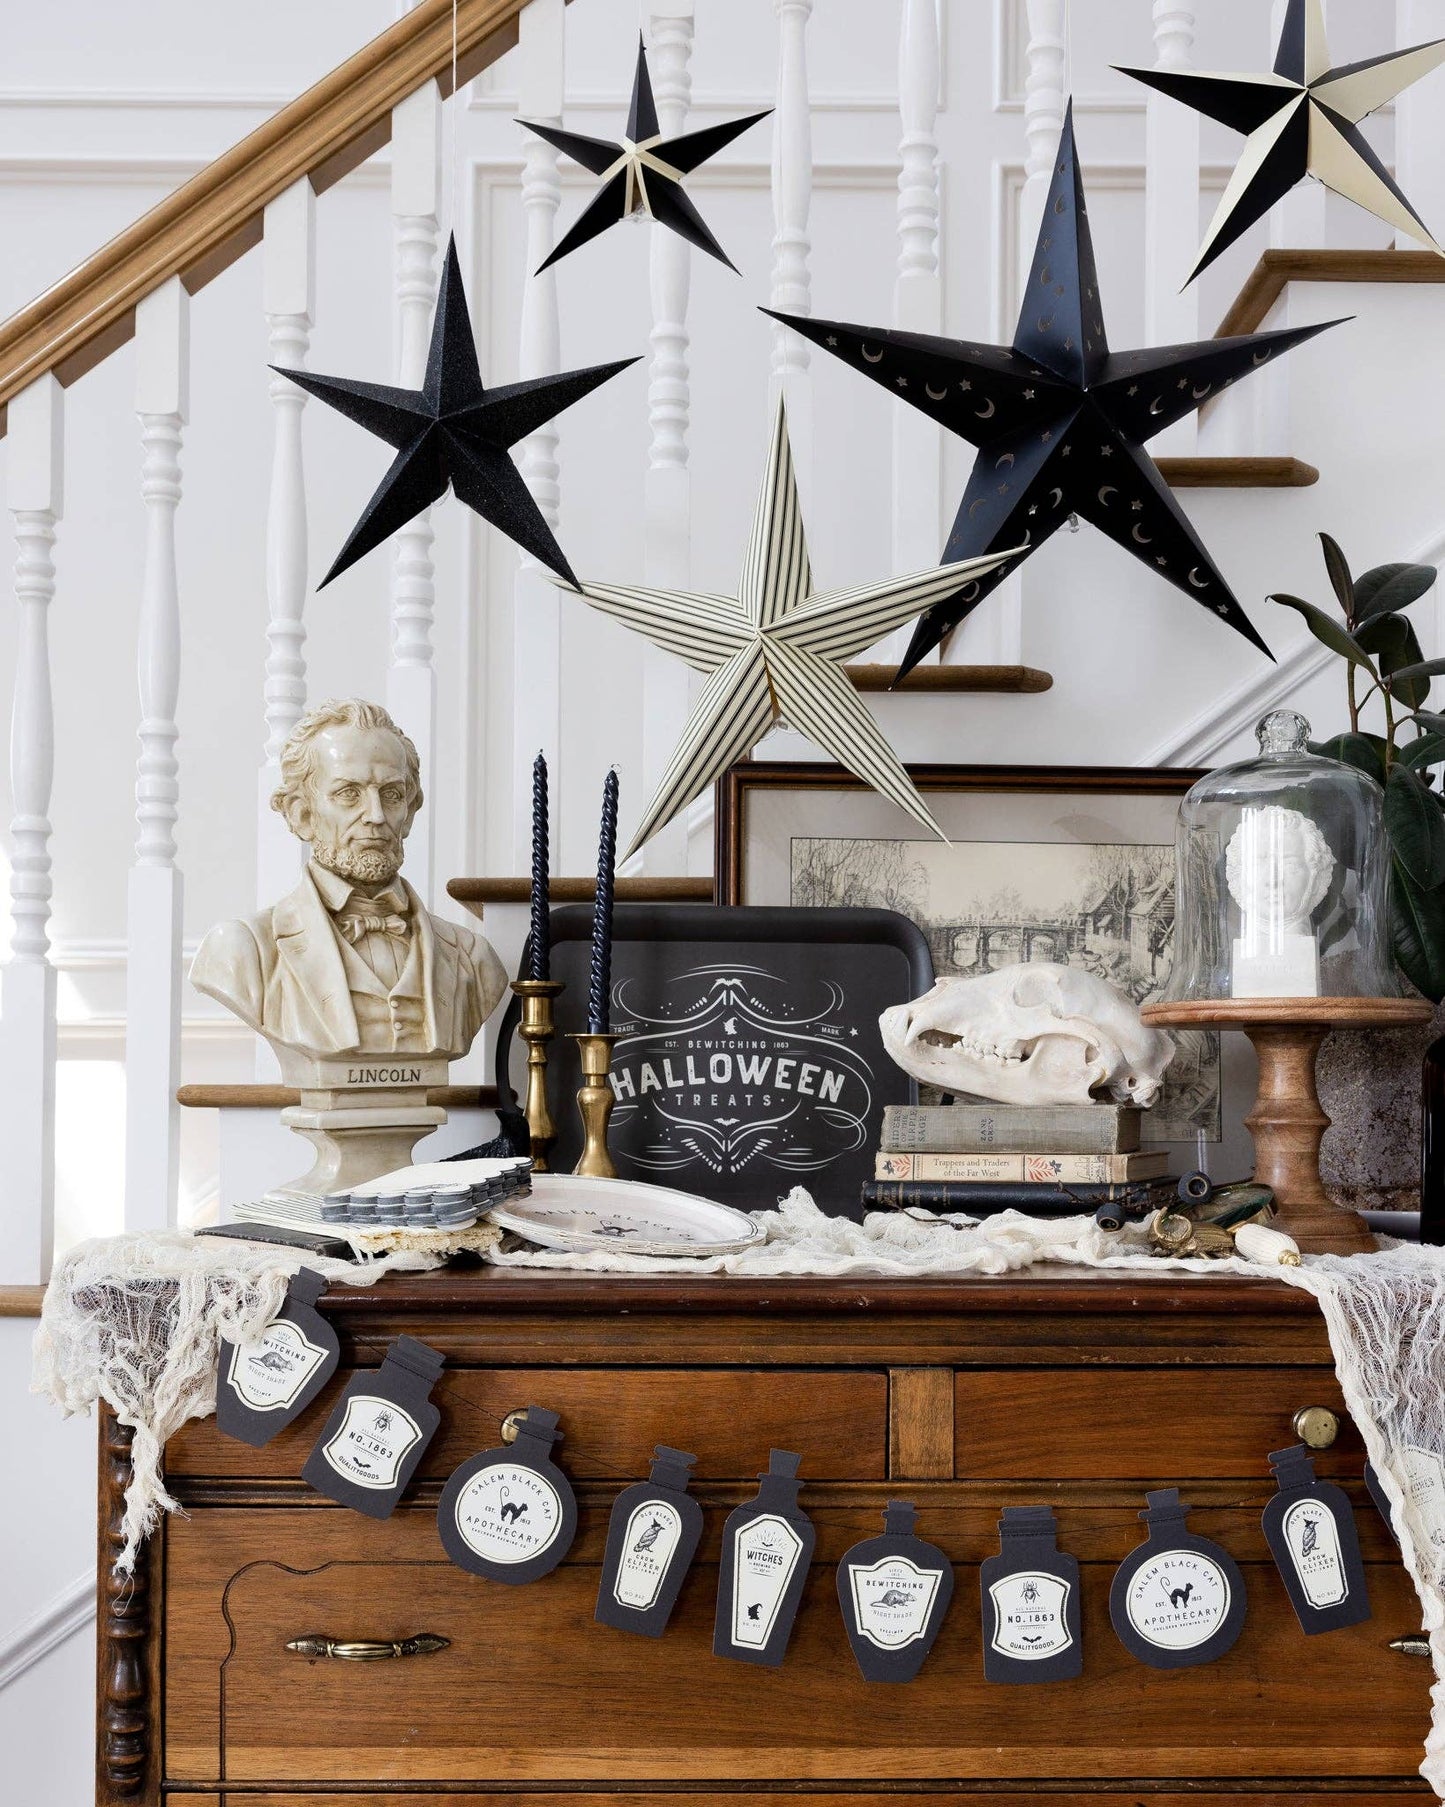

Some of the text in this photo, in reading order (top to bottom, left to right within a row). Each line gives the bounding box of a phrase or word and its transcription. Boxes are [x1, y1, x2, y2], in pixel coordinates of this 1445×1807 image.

[613, 1024, 840, 1036] TRADE MARK
[664, 1040, 680, 1048] EST.
[688, 1040, 767, 1049] BEWITCHING
[347, 1068, 422, 1084] LINCOLN
[608, 1053, 846, 1104] HALLOWEEN
[675, 1093, 772, 1107] TREATS
[892, 1109, 902, 1148] RIDERS
[908, 1110, 918, 1148] PURPLE
[919, 1115, 928, 1143] SAGE
[934, 1158, 1010, 1169] Trappers and Traders
[943, 1169, 1000, 1177] of the Far West
[471, 1473, 552, 1520] SALEM BLACK CAT
[466, 1515, 540, 1545] APOTHECARY
[627, 1558, 660, 1572] ELIXER
[747, 1550, 784, 1566] WITCHES
[1303, 1557, 1335, 1571] ELIXER
[866, 1580, 924, 1590] BEWITCHING
[1135, 1560, 1218, 1599] SALEM BLACK CAT
[1144, 1607, 1219, 1626] APOTHECARY
